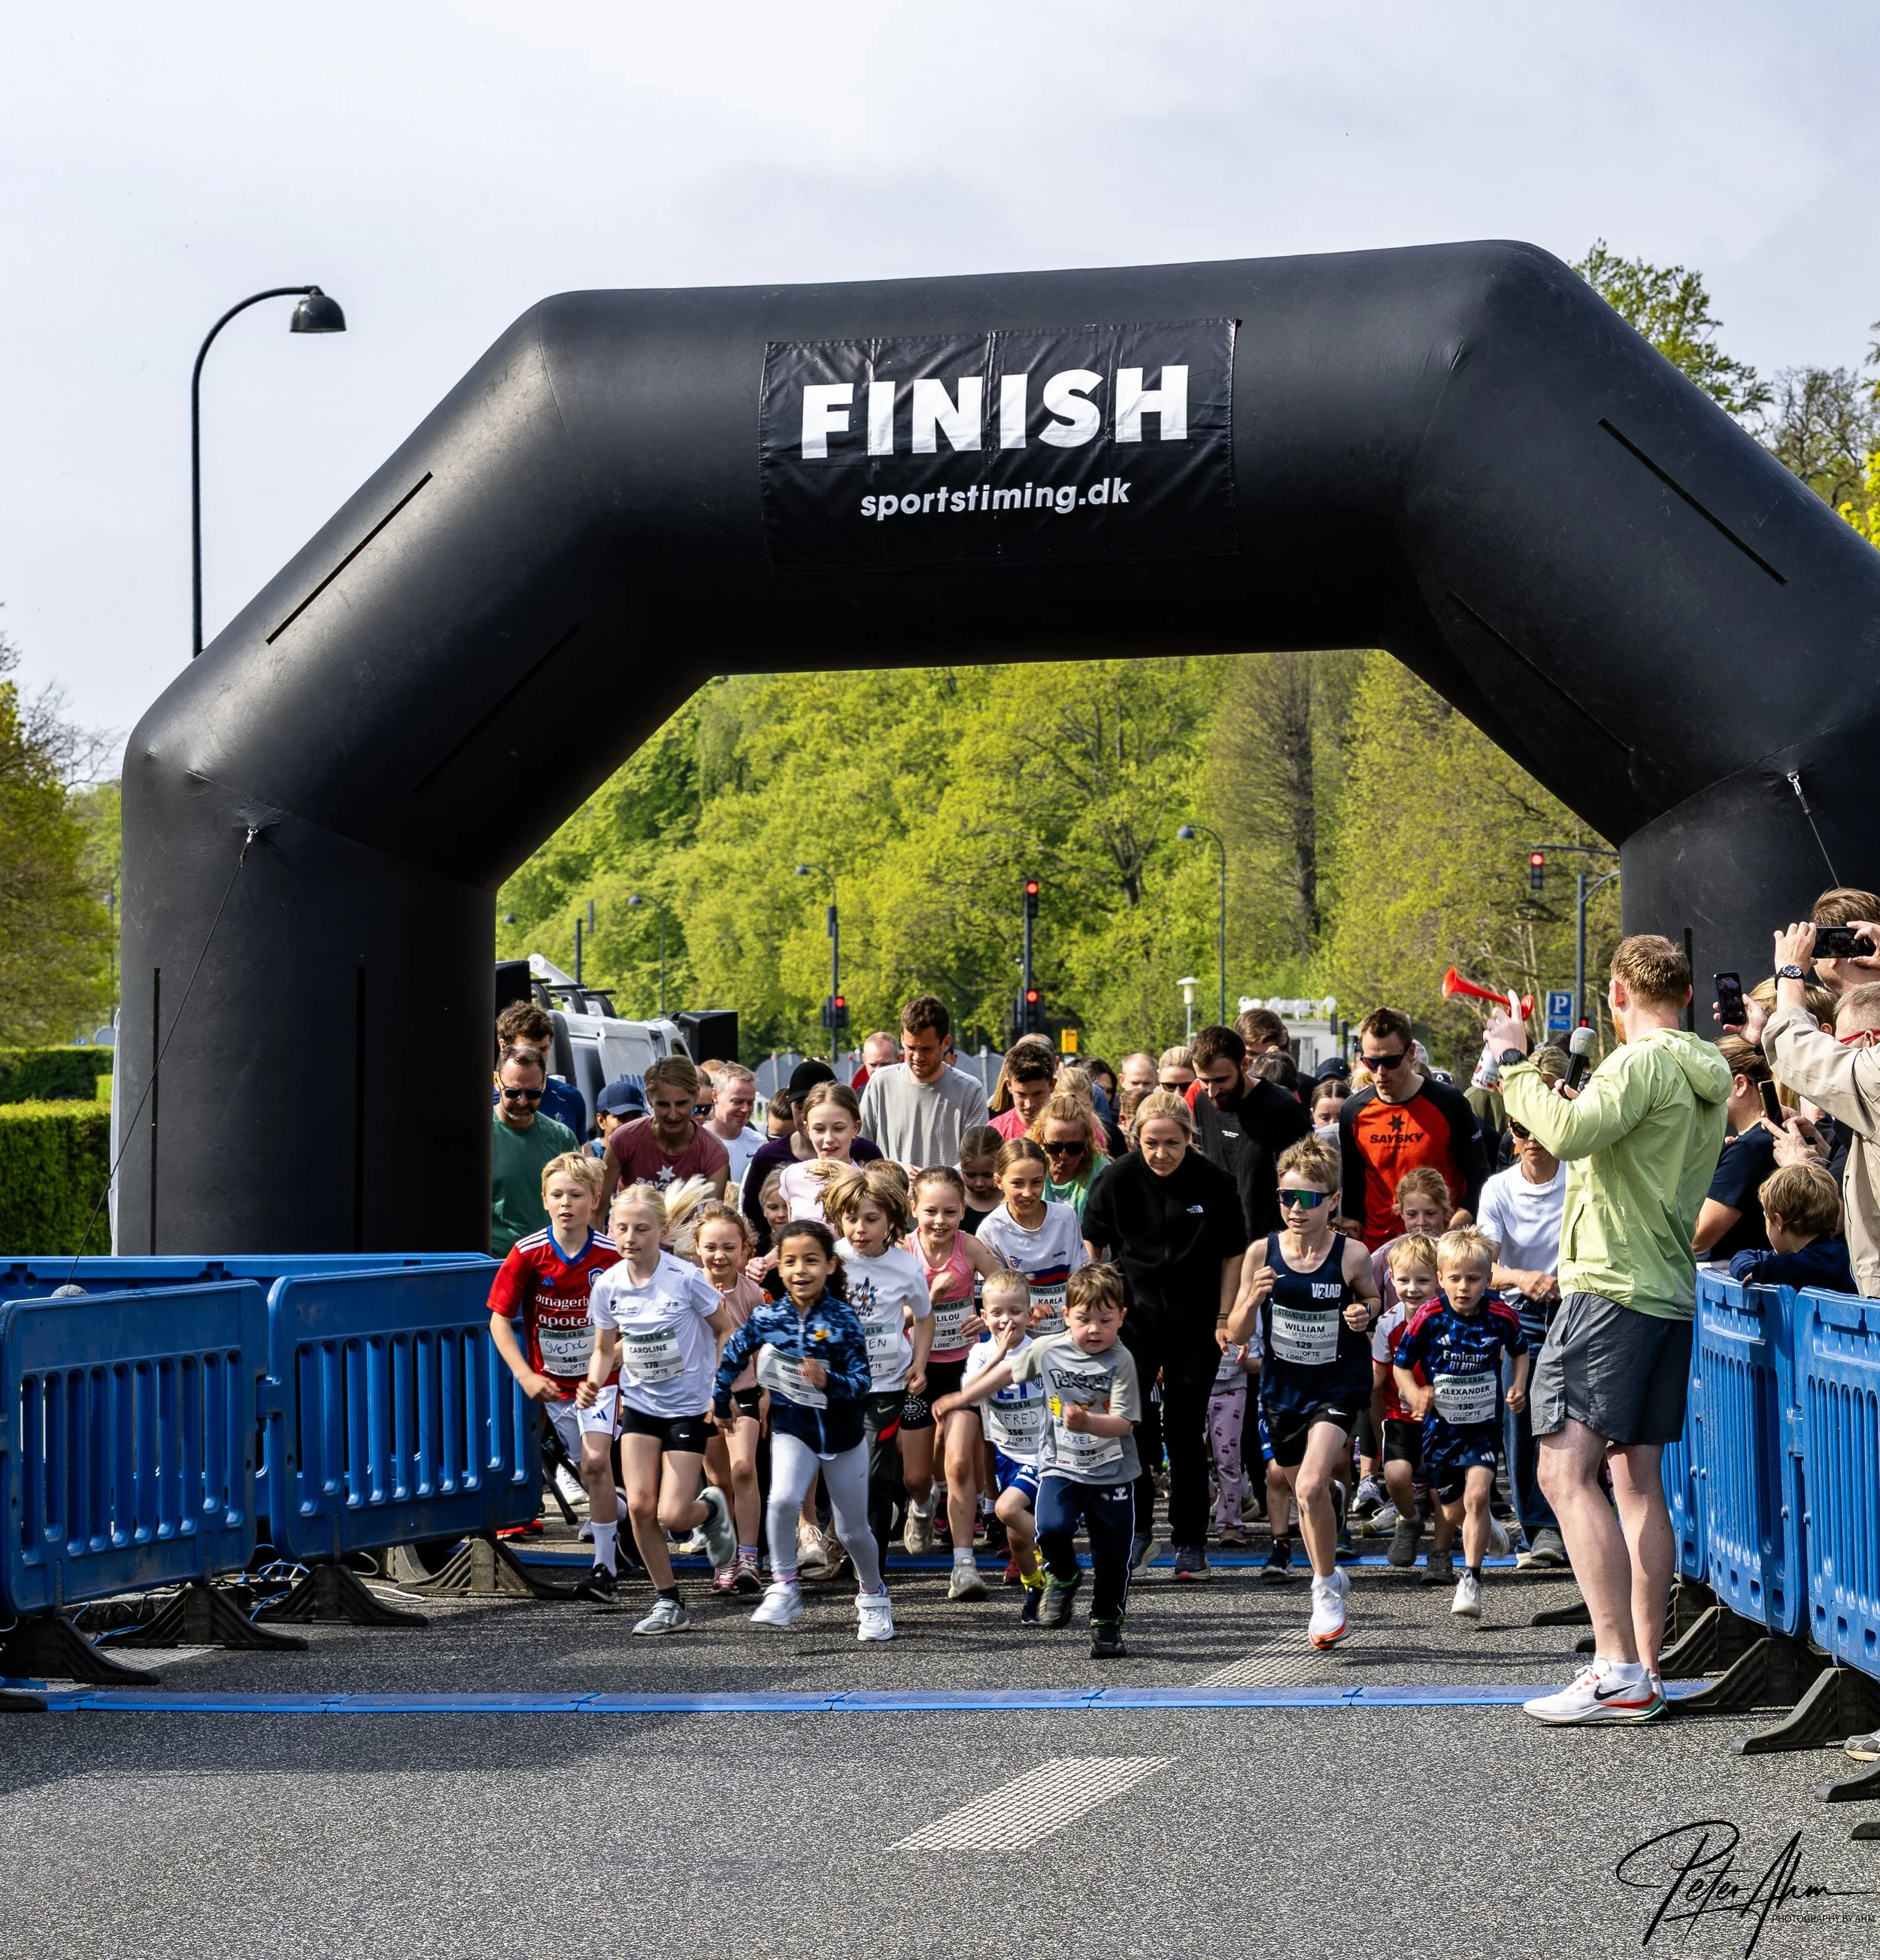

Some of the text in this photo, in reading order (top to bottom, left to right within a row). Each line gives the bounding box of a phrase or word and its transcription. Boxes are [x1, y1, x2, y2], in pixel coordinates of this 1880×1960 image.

[802, 365, 1189, 460] FINISH
[861, 478, 1132, 520] sportstiming.dk
[1553, 995, 1568, 1014] P
[1369, 1133, 1424, 1144] SAYSKY
[1030, 1286, 1060, 1294] TRANDVEJEN
[1311, 1283, 1342, 1299] V2LAB
[535, 1294, 589, 1309] amagerb
[1038, 1297, 1063, 1305] KARLA
[932, 1302, 958, 1312] ANDVEJEN
[936, 1313, 960, 1322] LILOU
[1278, 1309, 1318, 1321] STRANDVEJEN
[936, 1319, 963, 1327] ERGMANN
[1284, 1322, 1325, 1333] WILLIAM
[543, 1330, 577, 1338] STRANDVEJEN
[942, 1328, 957, 1337] 218
[1298, 1330, 1339, 1339] SPANGGAARD
[629, 1343, 668, 1354] CAROLINE
[1286, 1349, 1321, 1357] GENTOFTE
[1443, 1350, 1490, 1363] Emirates
[1449, 1361, 1460, 1370] FLY
[1440, 1385, 1490, 1396] ALEXANDER
[1461, 1390, 1496, 1400] SPANGGAARD
[1063, 1431, 1097, 1444] AXEL
